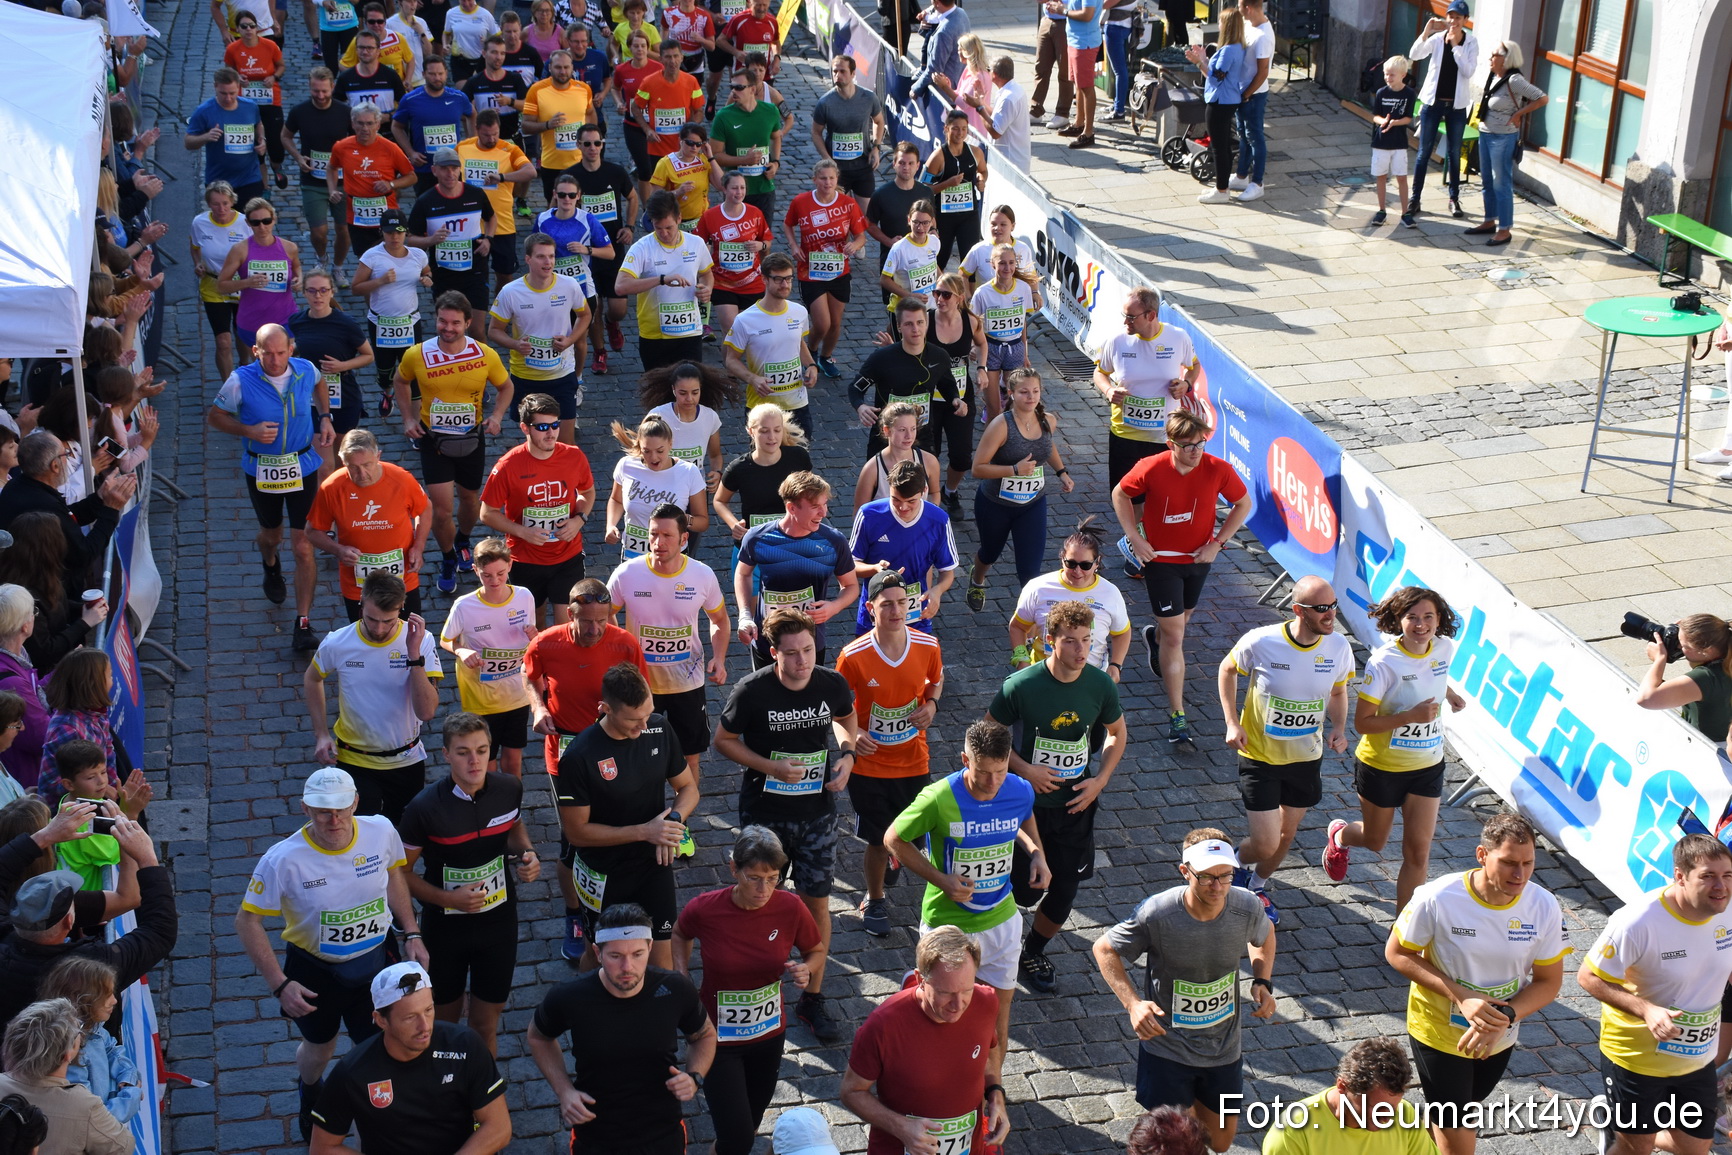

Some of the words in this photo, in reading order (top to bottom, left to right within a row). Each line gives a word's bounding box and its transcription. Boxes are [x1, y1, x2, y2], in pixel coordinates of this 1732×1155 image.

[245, 88, 269, 98] 2134
[657, 112, 683, 121] BOCK
[225, 124, 254, 134] BOCK
[428, 125, 455, 136] BOCK
[658, 119, 683, 130] 2541
[228, 134, 252, 145] 2281
[432, 135, 455, 146] 2163
[558, 132, 578, 143] 216
[833, 135, 863, 144] BOCK
[835, 142, 862, 152] 2295
[467, 162, 494, 171] BOCK
[355, 199, 386, 208] BOCK
[585, 195, 612, 206] BOCK
[945, 192, 971, 204] 2425
[586, 203, 613, 215] 2838
[440, 241, 470, 251] BOCK
[440, 250, 469, 262] 2119
[723, 250, 750, 264] 2263
[812, 253, 842, 264] BOCK
[252, 261, 287, 271] BOCK
[813, 261, 842, 273] 2261
[914, 273, 937, 290] 2641
[661, 303, 695, 314] BOCK
[989, 307, 1024, 320] BOCK
[380, 316, 412, 327] BOCK
[664, 312, 694, 326] 2461
[991, 317, 1022, 332] 2519
[380, 326, 410, 338] 2307
[529, 347, 560, 361] 2318
[427, 368, 455, 380] MAX
[459, 360, 488, 374] BÖGL
[767, 359, 799, 373] BOCK
[770, 369, 799, 385] 1272
[1126, 396, 1166, 407] BOCK
[433, 403, 471, 413] BOCK
[1126, 407, 1162, 421] 2497
[435, 413, 471, 427] 2406
[1127, 419, 1159, 428] MATHIAS
[1229, 424, 1251, 453] ONLINE
[260, 456, 297, 467] BOCK
[1229, 451, 1252, 481] MOBILE
[262, 466, 297, 481] 1056
[262, 480, 298, 490] CHRISTOF
[1005, 480, 1040, 493] 2112
[1272, 442, 1333, 540] Hervis
[527, 506, 568, 518] BOCK
[351, 518, 389, 529] funrunners
[362, 523, 394, 532] neumarkt
[359, 549, 399, 564] BOCK
[676, 584, 685, 592] 20
[768, 588, 810, 604] BOCK
[507, 610, 517, 619] 20
[643, 626, 689, 639] BOCK
[644, 639, 688, 654] 2620
[389, 652, 401, 660] 20
[654, 655, 676, 663] RALF
[1314, 655, 1324, 664] 20
[1430, 660, 1439, 668] 20
[875, 703, 916, 719] BOCK
[1273, 699, 1319, 712] BOCK
[767, 706, 817, 723] Reebok
[1271, 711, 1316, 728] 2804
[768, 716, 833, 733] WEIGHTLIFTING
[879, 731, 911, 743] NIKLAS
[1399, 724, 1438, 738] 2414
[1039, 738, 1085, 753] BOCK
[1395, 738, 1438, 749] ELISABETH
[1038, 750, 1084, 769] 2105
[775, 782, 813, 792] NICOLAI
[966, 817, 1020, 836] Freitag
[959, 843, 1009, 861] BOCK
[353, 855, 367, 867] 20
[355, 859, 384, 873] Neumarkter
[356, 867, 380, 880] Stadtlauf
[449, 861, 499, 881] BOCK
[960, 858, 1007, 879] 2132
[248, 878, 265, 896] 20
[303, 877, 327, 889] BOCK
[326, 901, 379, 925] BOCK
[327, 917, 380, 943] 2824
[1508, 919, 1521, 930] 20
[1451, 926, 1477, 937] BOCK
[1507, 930, 1538, 938] Neumarkter
[1715, 928, 1726, 939] 20
[1661, 949, 1687, 961] BOCK
[1179, 976, 1231, 996] BOCK
[724, 986, 776, 1004] BOCK
[1179, 990, 1230, 1015] 2099
[725, 999, 776, 1026] 2270
[1178, 1005, 1231, 1023] CHRISTOPHER
[735, 1022, 768, 1036] KATJA
[431, 1050, 467, 1061] STEFAN
